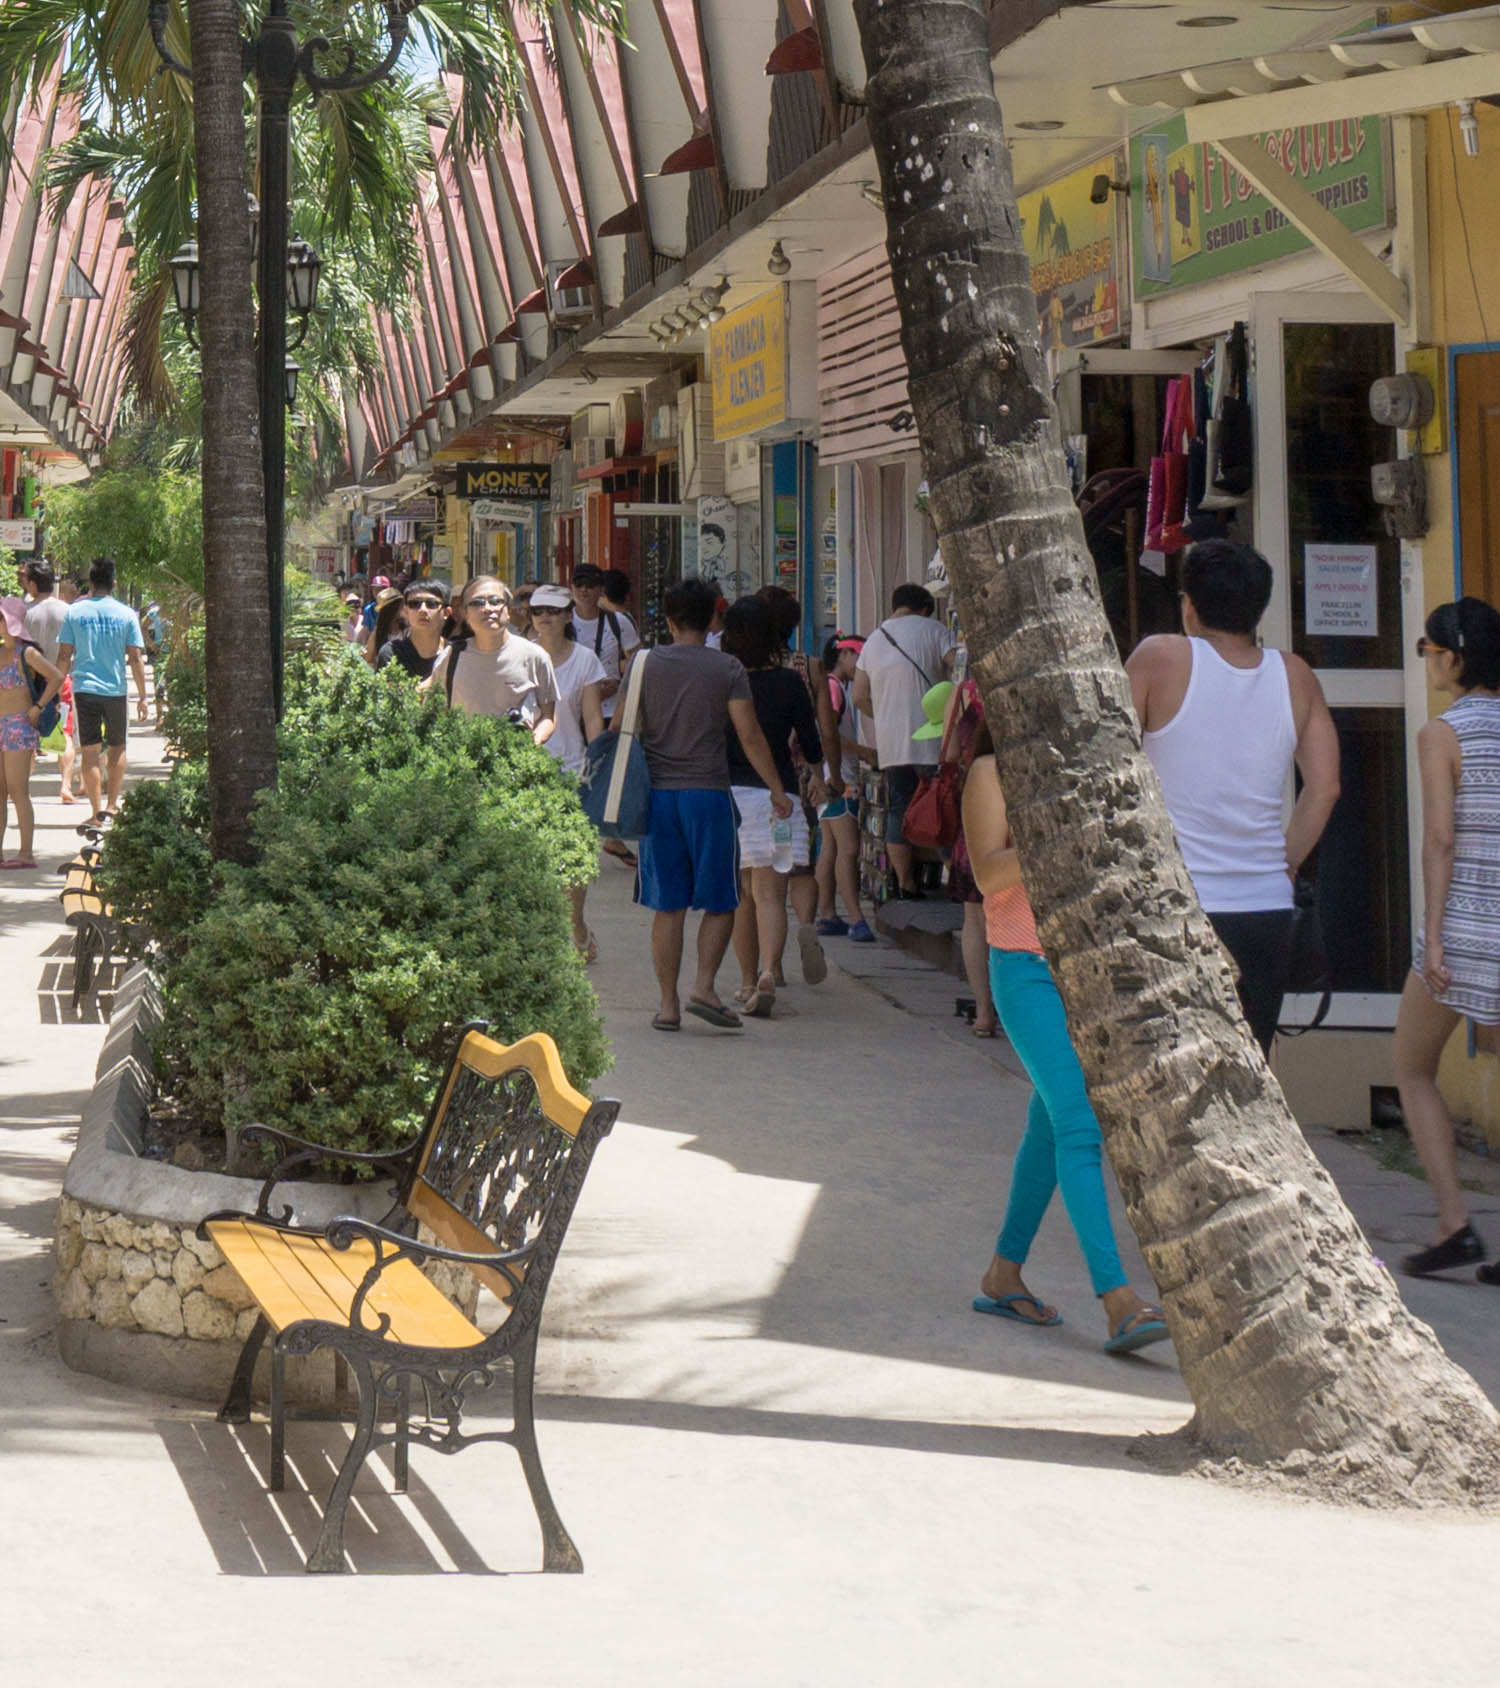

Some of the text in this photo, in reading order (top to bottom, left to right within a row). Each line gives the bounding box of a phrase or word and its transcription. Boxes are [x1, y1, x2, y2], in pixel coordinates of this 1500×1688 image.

[1206, 216, 1250, 253] SCHOOL
[1312, 173, 1370, 211] UPPLIES
[466, 470, 549, 494] MONEY
[479, 485, 550, 495] CHANGER
